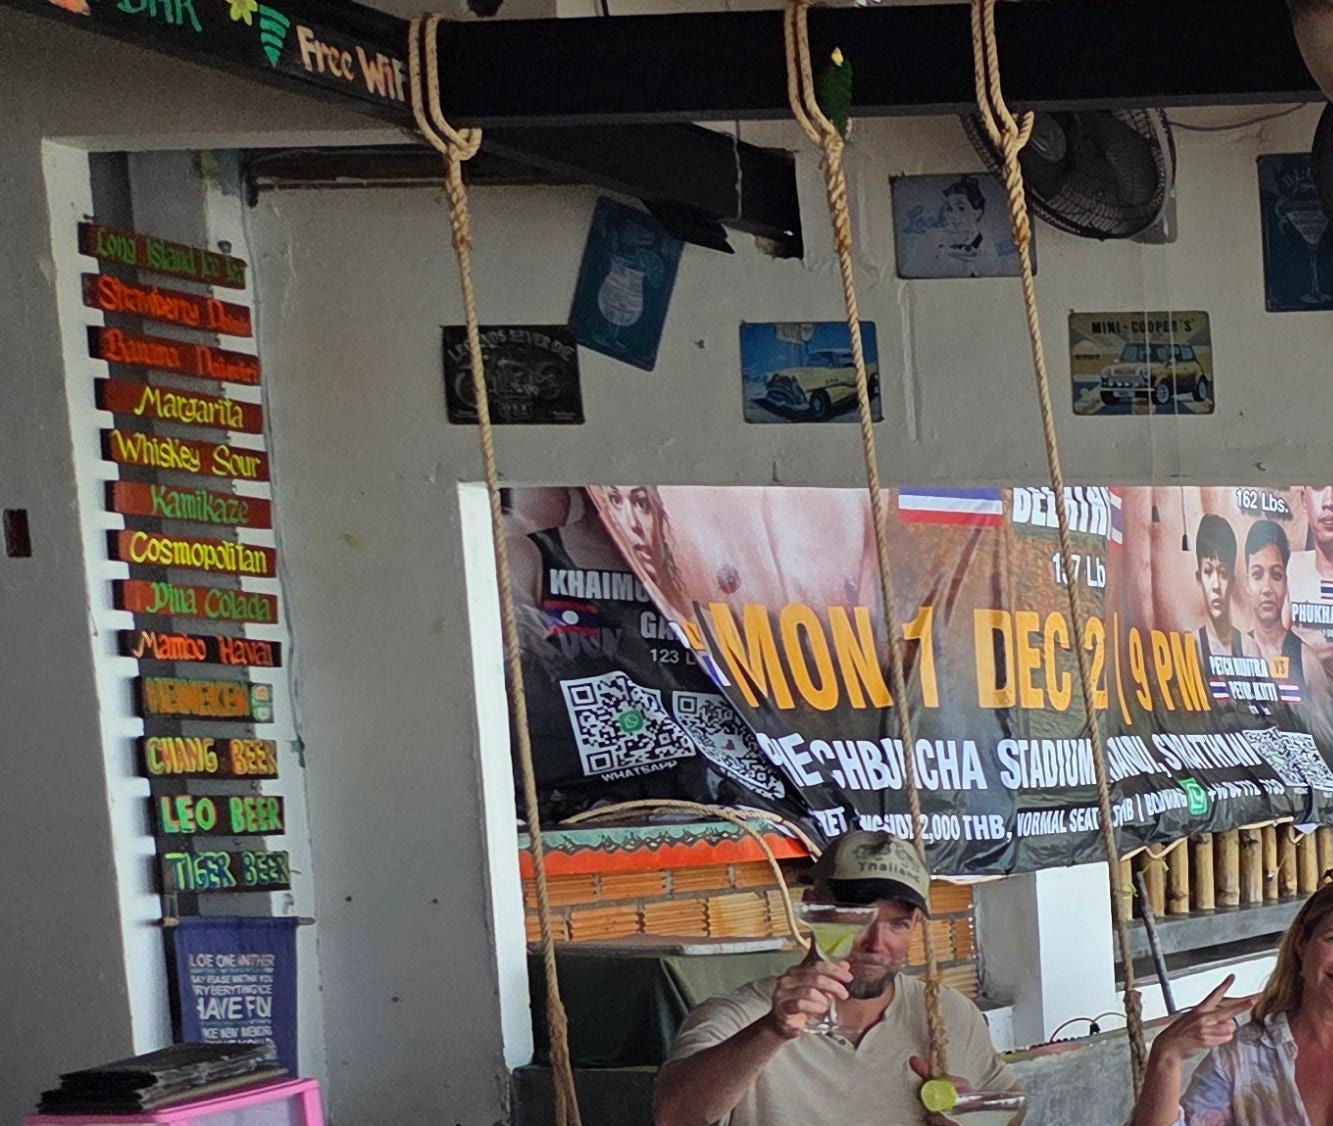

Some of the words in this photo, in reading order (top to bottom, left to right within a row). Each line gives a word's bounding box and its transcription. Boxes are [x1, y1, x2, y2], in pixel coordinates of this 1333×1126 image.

[297, 25, 355, 81] Free
[133, 384, 244, 428] Margarita
[111, 429, 201, 473] Whiskey
[211, 444, 262, 478] Sour
[150, 484, 249, 524] Kamikaze
[1236, 488, 1258, 509] 162
[1261, 493, 1290, 514] Lbs.
[129, 530, 268, 574] Cosmopolitan
[1053, 553, 1081, 585] 17
[204, 587, 272, 620] Colada
[132, 629, 207, 661] Mambo
[650, 648, 680, 664] 123
[709, 602, 895, 710] MON
[903, 606, 939, 708] 1
[973, 608, 1072, 712] DEC
[1128, 626, 1154, 713] 9
[1150, 628, 1211, 713] PM
[146, 736, 219, 774] CHANG
[229, 738, 279, 775] BEER
[601, 759, 678, 782] WHATSAPP
[997, 738, 1097, 790] STADIUM
[160, 795, 218, 834] LEO
[229, 796, 282, 834] BEER
[919, 814, 961, 845] 2,000
[962, 814, 1013, 844] THB,
[1069, 807, 1101, 833] SEAT
[164, 851, 237, 891] TIGER
[243, 851, 291, 887] BEER
